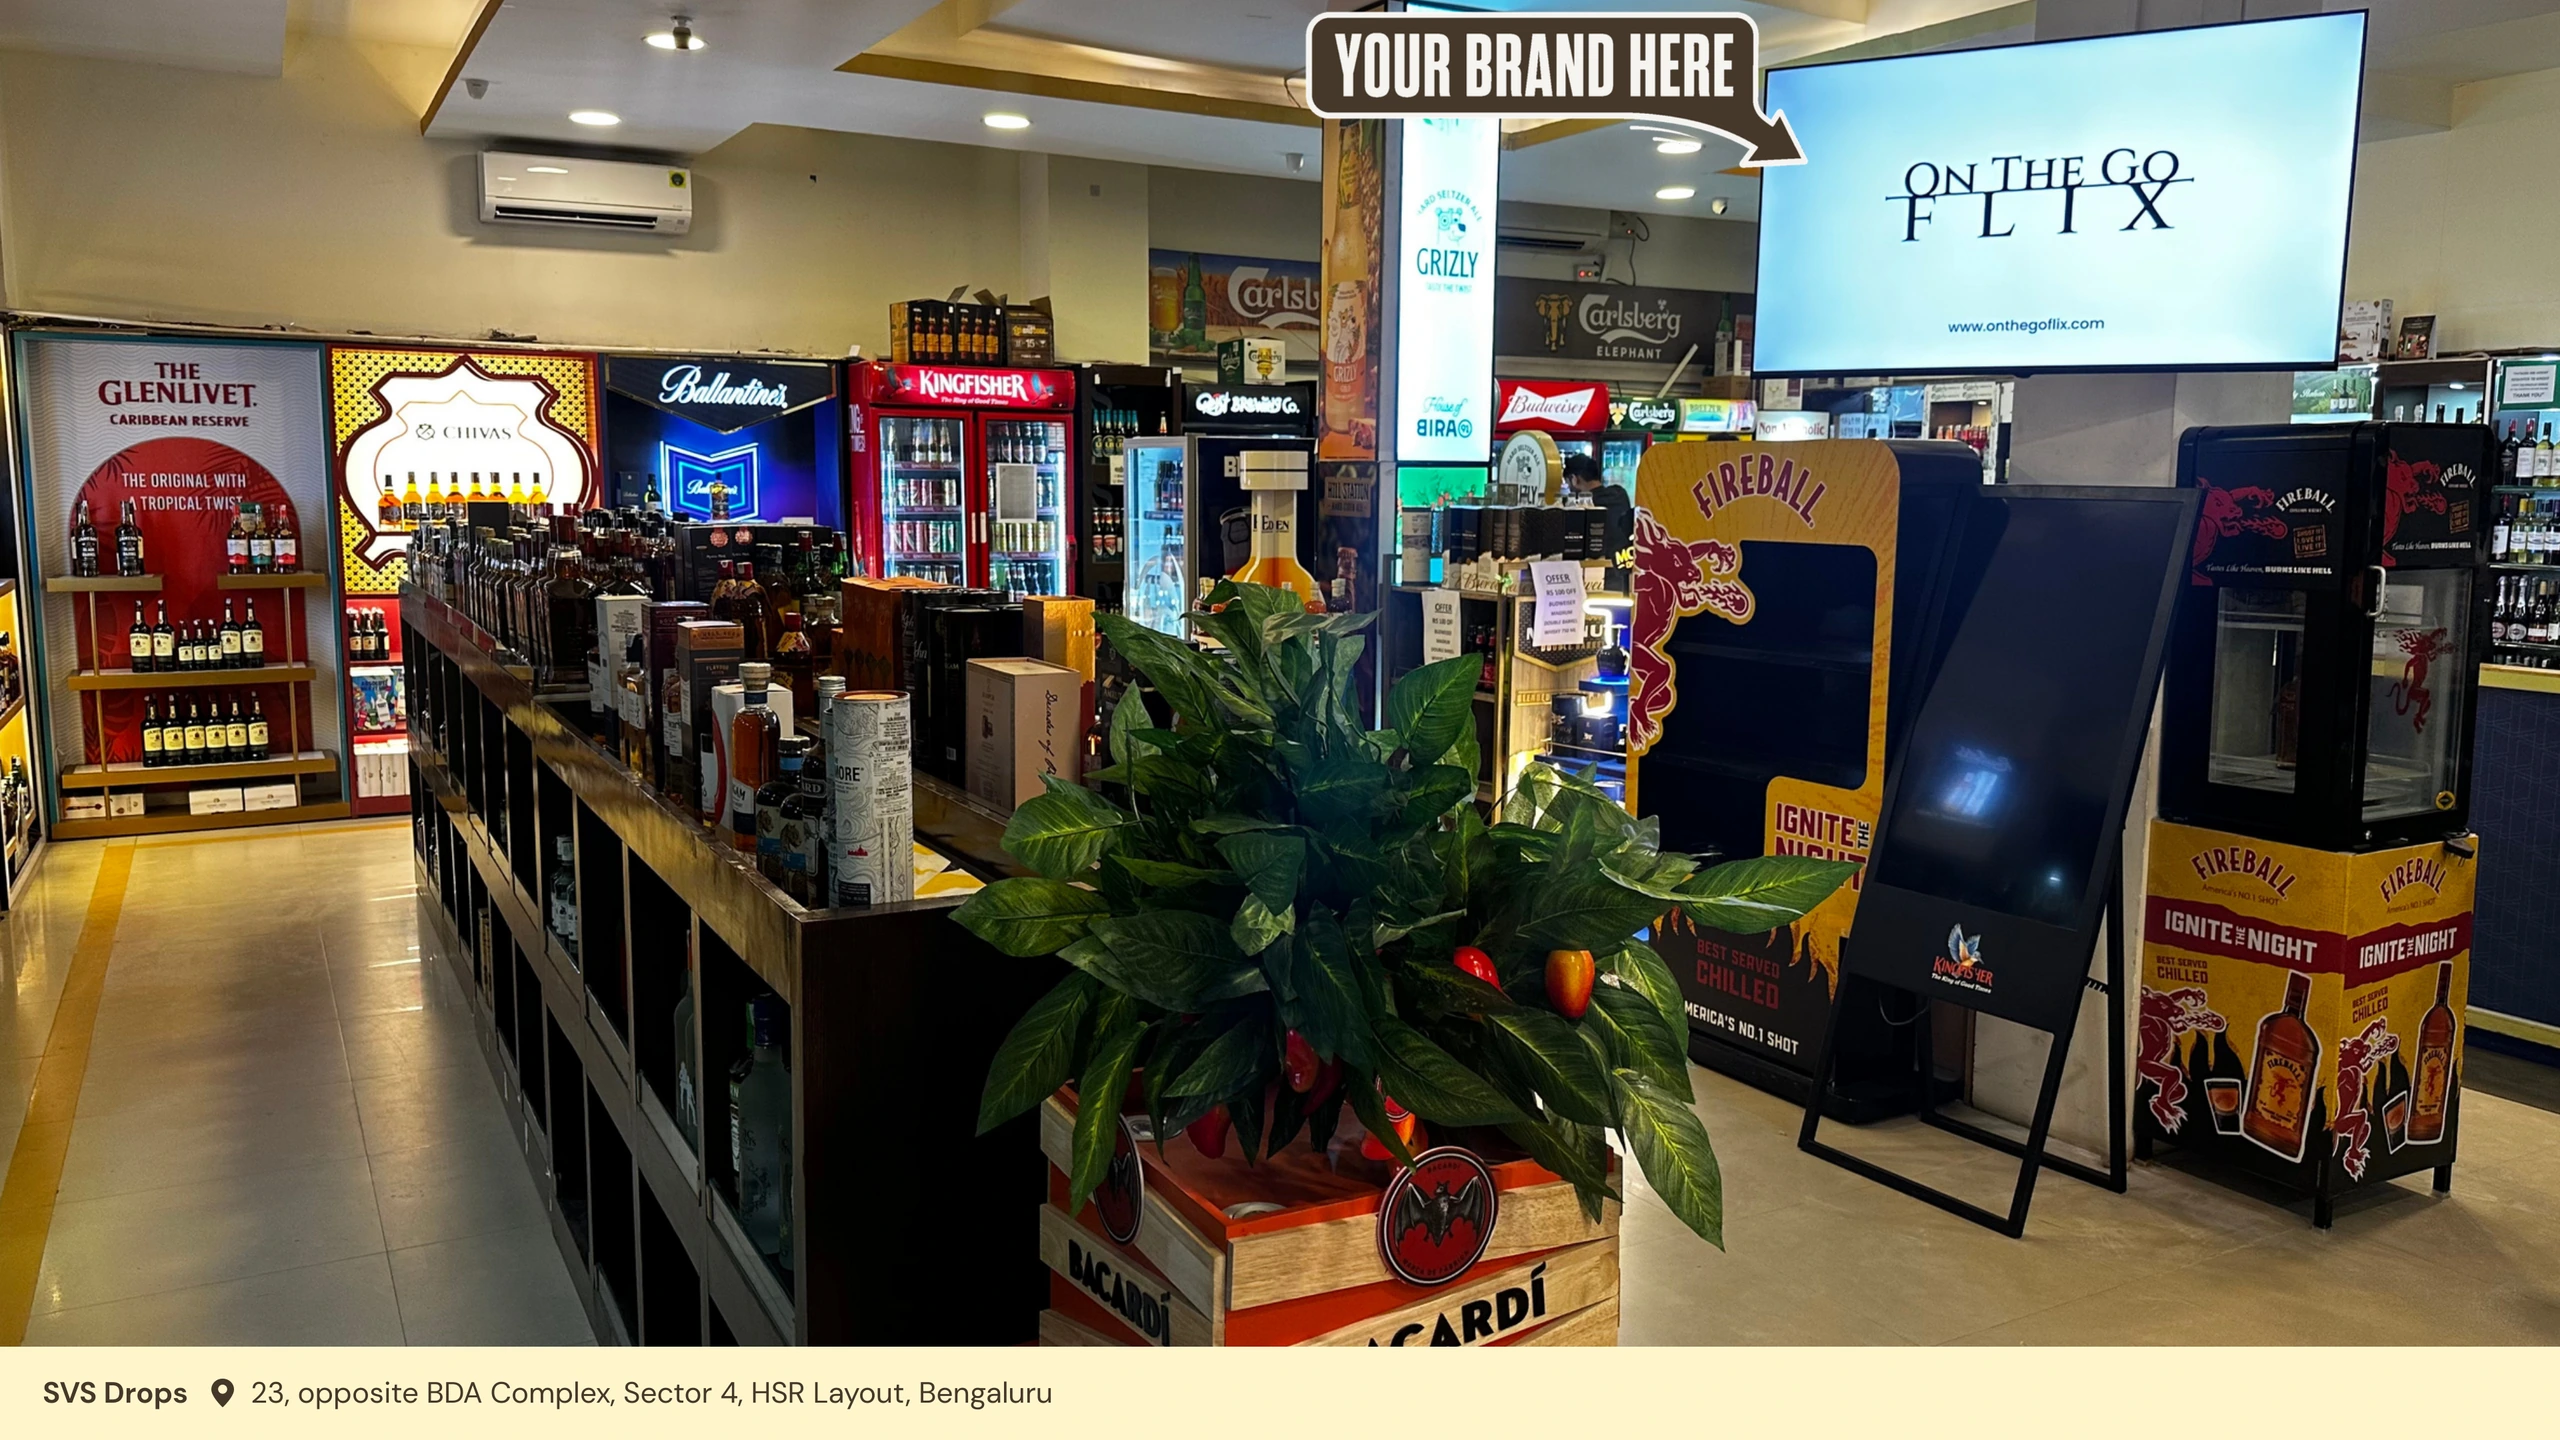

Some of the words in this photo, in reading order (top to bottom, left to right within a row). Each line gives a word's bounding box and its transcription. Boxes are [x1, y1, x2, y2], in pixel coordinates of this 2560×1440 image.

[1904, 162, 1978, 197] ON
[1991, 155, 2085, 192] THE
[2101, 148, 2180, 186] GO
[1437, 190, 1471, 207] SELTZER
[1901, 182, 2175, 242] FLIX
[1416, 248, 1479, 278] GRIZLY
[1579, 294, 1682, 344] Carlsberg
[1948, 317, 2105, 335] www.onthegoflix.com
[1597, 346, 1662, 360] ELEPHANT
[154, 362, 200, 379] THE
[1333, 364, 1357, 383] GRIZLY
[919, 370, 1029, 401] KINGFISHER
[941, 396, 952, 404] The
[975, 397, 990, 405] Good
[991, 398, 1009, 406] Times
[1509, 394, 1586, 414] Budweiser
[1689, 403, 1722, 412] BREEZER
[110, 414, 187, 426] CARIBBEAN
[192, 415, 249, 427] RESERVE
[1628, 402, 1676, 426] Carlsberg
[444, 426, 511, 440] CHIVAS
[122, 473, 147, 487] THE
[151, 473, 210, 488] ORIGINAL
[214, 473, 246, 488] WITH
[2440, 463, 2476, 489] FIREBALL
[140, 496, 202, 511] TROPICAL
[1545, 574, 1571, 585] OFFER
[2226, 563, 2240, 573] Like
[2265, 566, 2293, 574] BURNS
[2293, 566, 2311, 574] LIKE
[2312, 567, 2332, 575] HELL
[1434, 603, 1452, 612] OFFER
[1776, 802, 1856, 847] IGNITE
[1858, 821, 1870, 849] THE
[2202, 883, 2237, 898] America's
[2258, 895, 2280, 906] SHOT
[2386, 903, 2410, 914] America's
[2422, 897, 2437, 908] SHOT
[2164, 909, 2234, 945] IGNITE
[2235, 925, 2246, 946] THE
[2247, 928, 2318, 964] NIGHT
[2359, 937, 2406, 969] IGNITE
[2406, 937, 2415, 958] THE
[2414, 927, 2458, 957] NIGHT
[1697, 938, 1727, 961] BEST
[1731, 949, 1780, 980] SERVED
[2156, 955, 2176, 966] BEST
[2177, 957, 2208, 969] SERVED
[1697, 960, 1779, 1010] CHILLED
[1931, 972, 1941, 980] The
[1941, 975, 1954, 985] King
[1960, 980, 1975, 989] Good
[1975, 984, 1992, 994] Times
[2157, 966, 2209, 985] CHILLED
[2352, 994, 2366, 1009] BEST
[2367, 986, 2389, 1002] SERVED
[2352, 997, 2389, 1024] CHILLED
[1684, 1000, 1735, 1032] MERICA'S
[1767, 1032, 1799, 1055] SHOT
[2267, 1058, 2302, 1080] FIREBALL
[1402, 1258, 1424, 1275] MARCA
[1068, 1239, 1171, 1347] BACARDÍ
